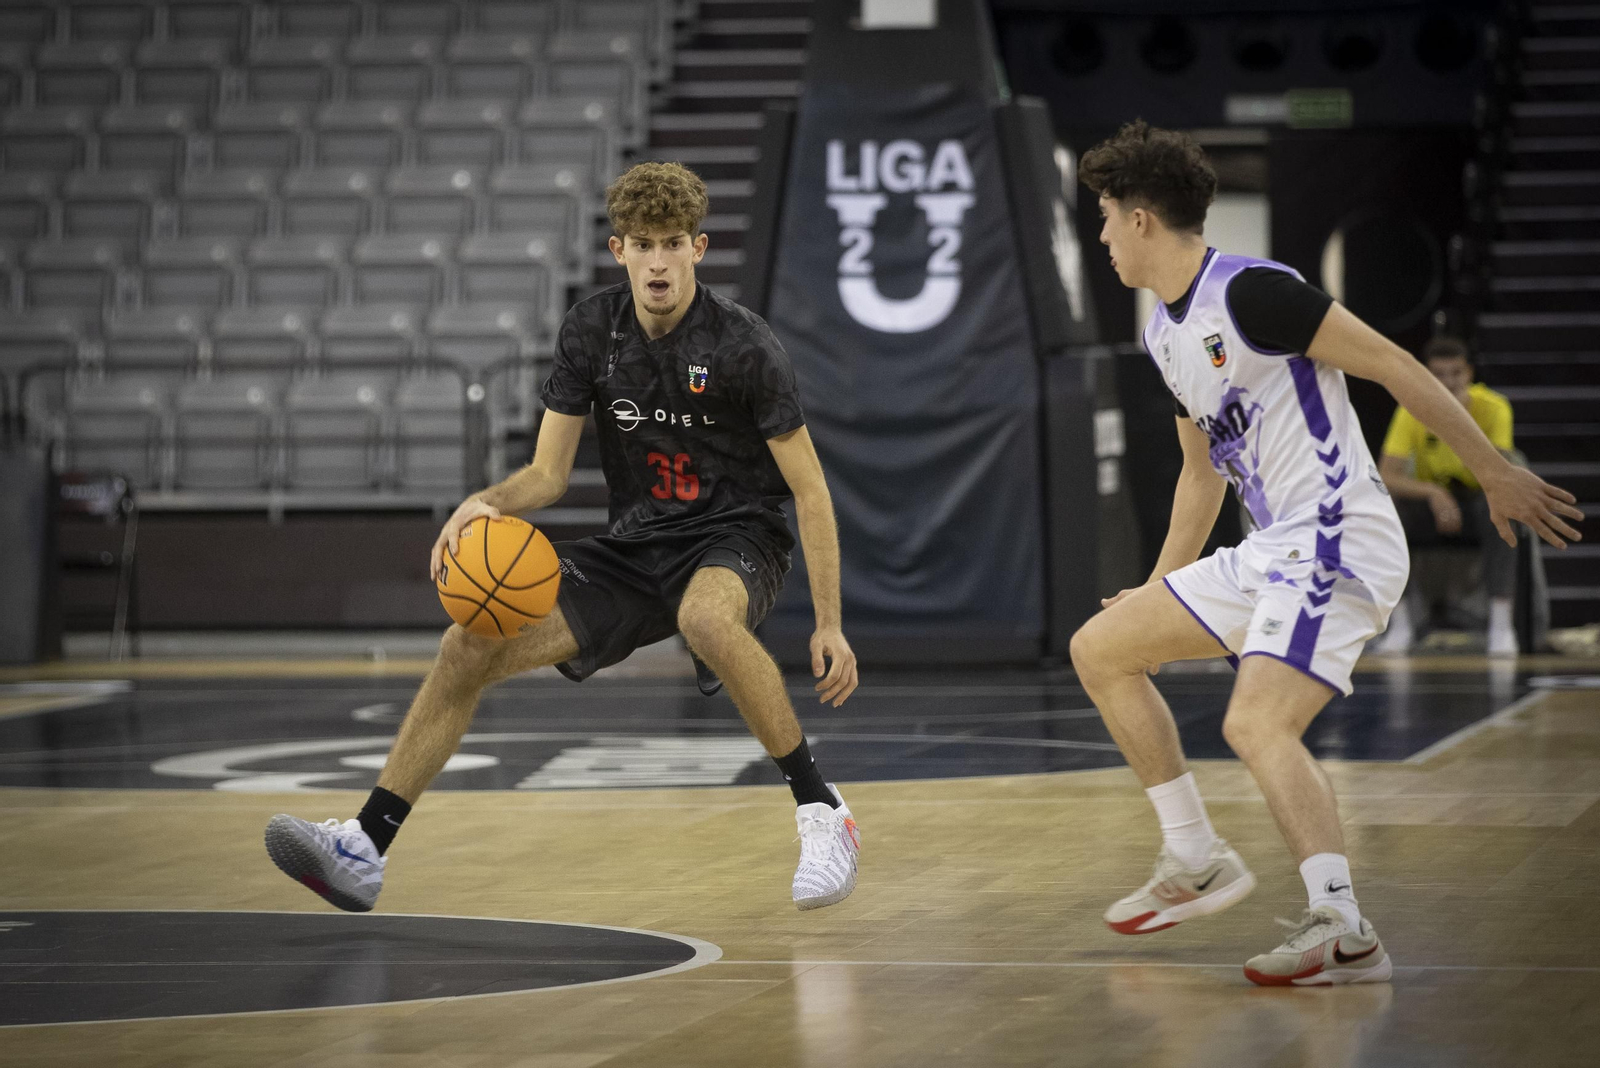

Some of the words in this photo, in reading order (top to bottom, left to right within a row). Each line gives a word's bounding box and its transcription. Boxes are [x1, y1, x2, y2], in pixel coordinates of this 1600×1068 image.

[825, 138, 976, 193] LIGA
[688, 364, 708, 375] LIGA
[647, 452, 700, 501] 36
